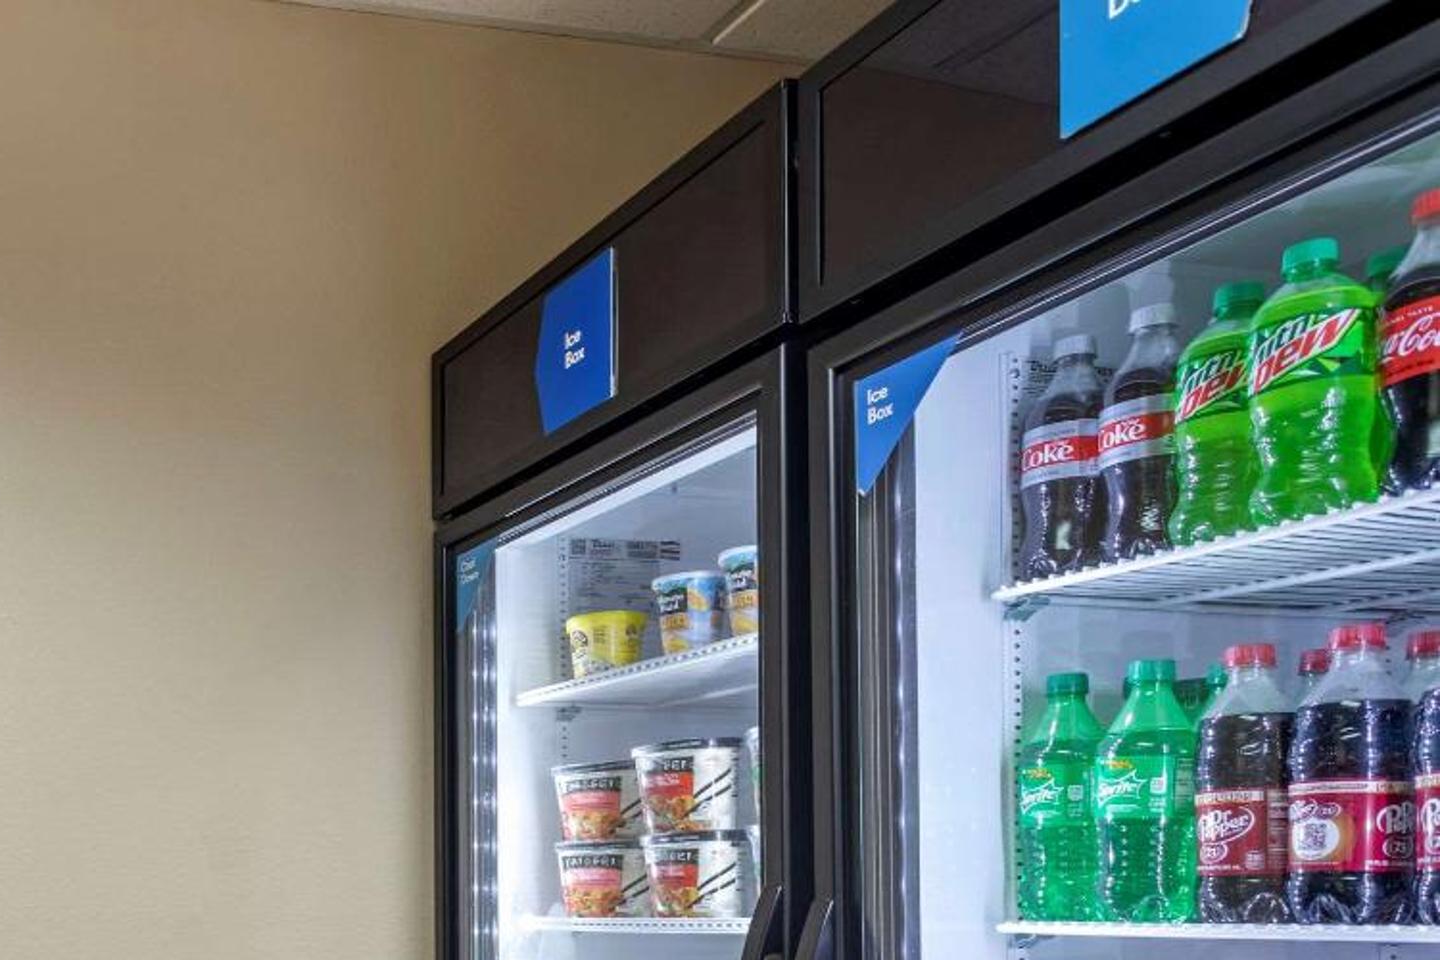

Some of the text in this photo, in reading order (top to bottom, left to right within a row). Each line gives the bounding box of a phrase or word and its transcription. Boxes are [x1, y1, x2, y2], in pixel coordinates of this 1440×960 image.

[564, 330, 581, 350] Ice
[564, 347, 585, 369] Box
[867, 387, 888, 405] Ice
[867, 402, 894, 425] Box
